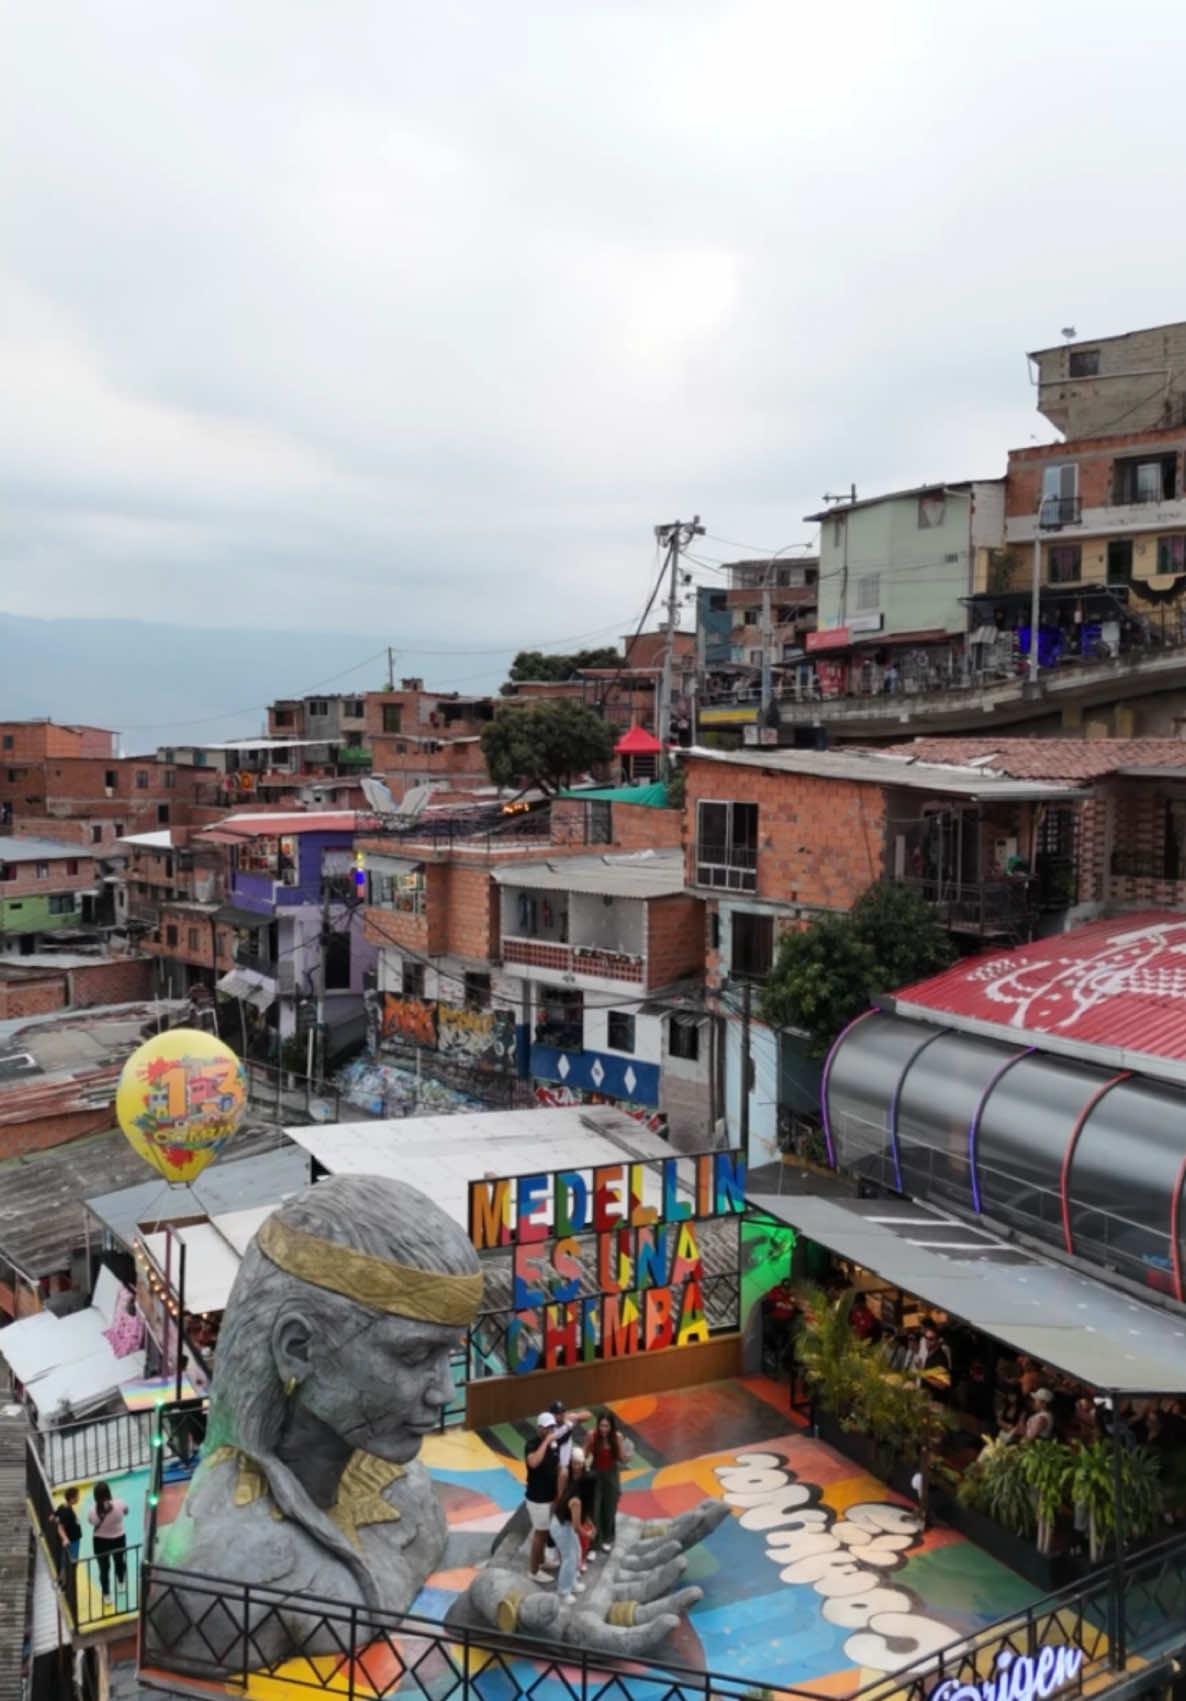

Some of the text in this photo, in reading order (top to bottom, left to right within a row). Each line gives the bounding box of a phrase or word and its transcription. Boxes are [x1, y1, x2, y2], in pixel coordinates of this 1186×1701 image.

[160, 1058, 248, 1117] 13
[471, 1151, 746, 1249] MEDELLIN
[514, 1220, 703, 1310] ES UNA
[506, 1280, 710, 1374] CHIMBA
